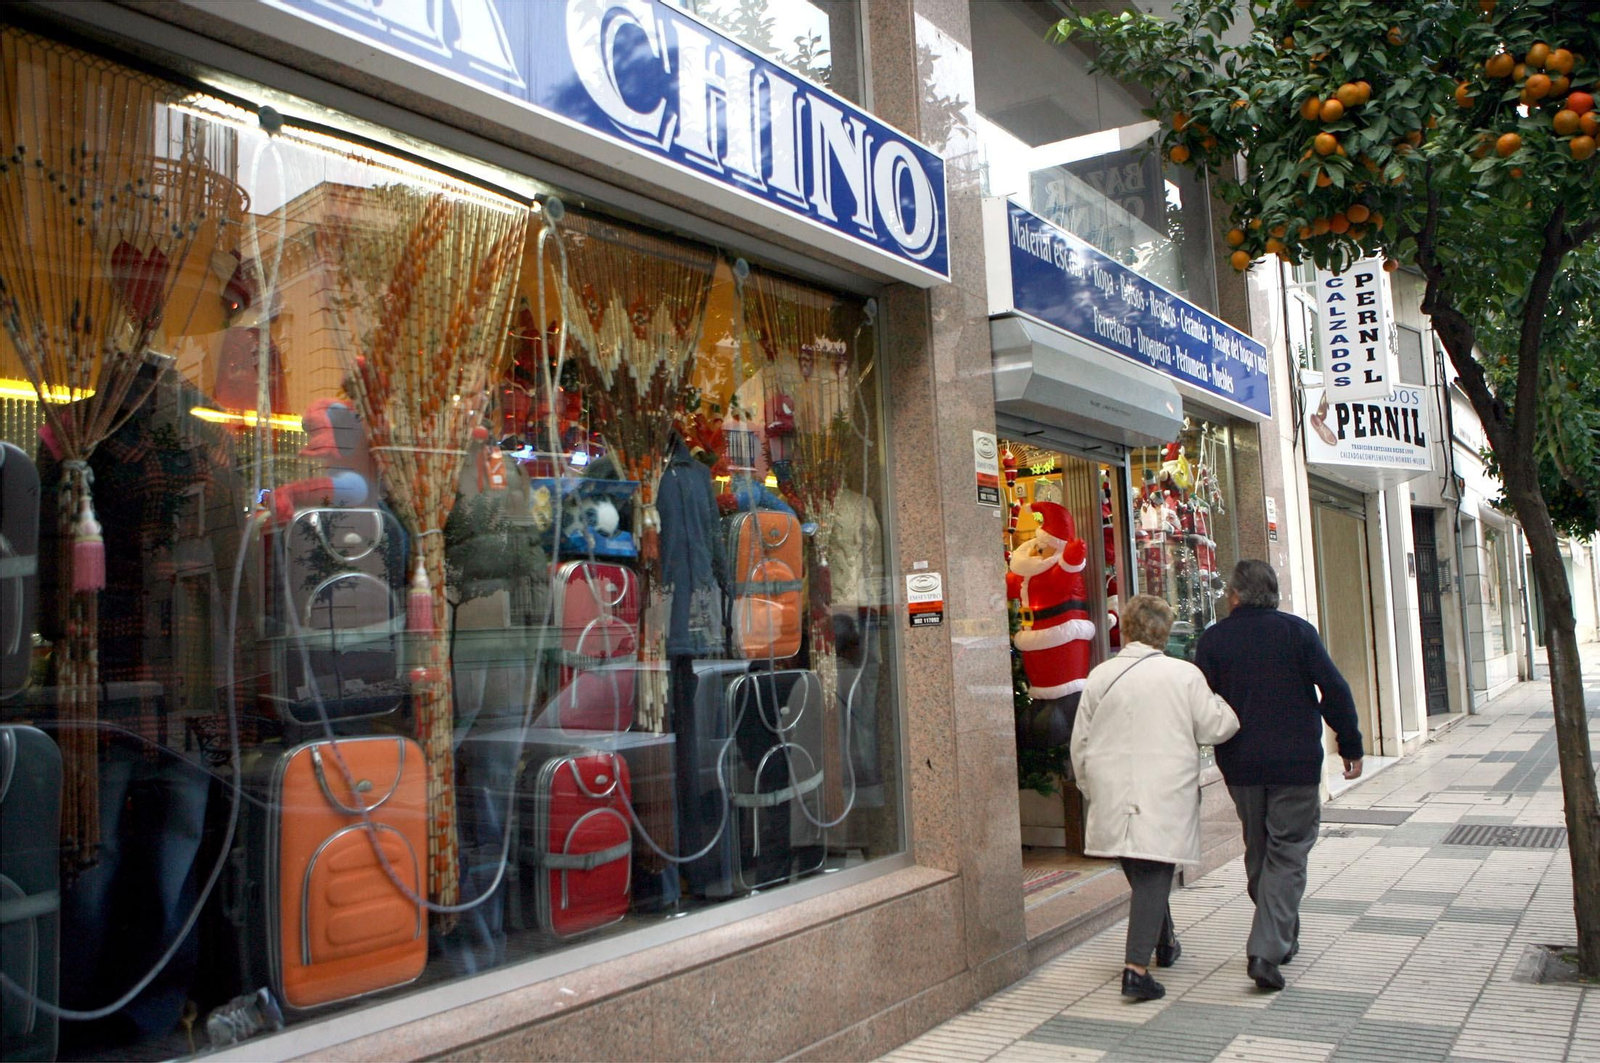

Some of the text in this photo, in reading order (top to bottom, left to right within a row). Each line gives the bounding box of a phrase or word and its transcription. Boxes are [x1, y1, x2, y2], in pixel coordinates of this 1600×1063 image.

[565, 0, 936, 260] CHINO
[1011, 214, 1052, 264] Material
[1093, 260, 1114, 299] Ropa
[1149, 290, 1176, 328] Regalos
[1230, 336, 1240, 360] del
[1239, 340, 1254, 372] hogar
[1325, 277, 1352, 387] CALZADOS
[1354, 272, 1382, 384] PERNIL
[1093, 305, 1132, 348] Ferretería
[1137, 326, 1171, 366] Droguería
[1211, 362, 1234, 394] Muebles
[1335, 402, 1426, 448] PERNIL
